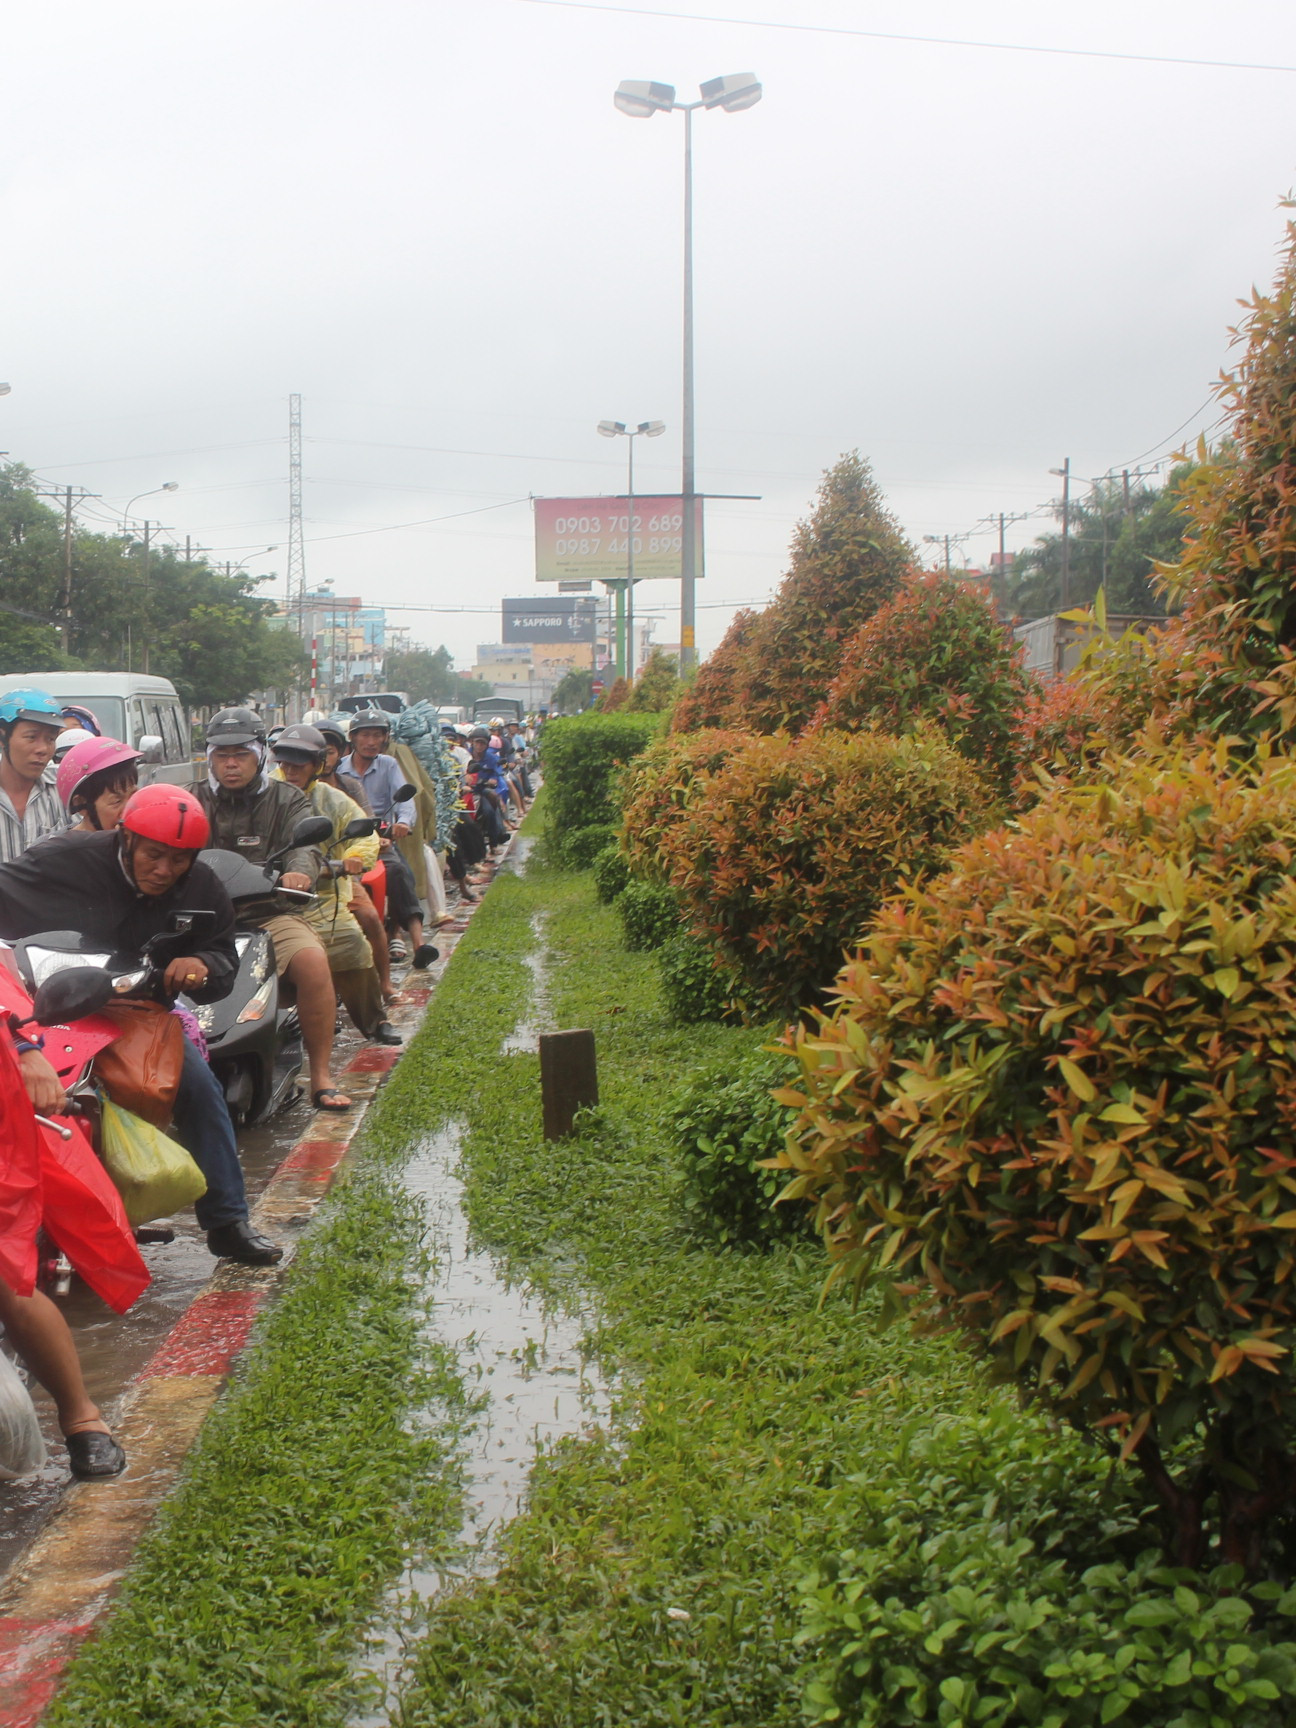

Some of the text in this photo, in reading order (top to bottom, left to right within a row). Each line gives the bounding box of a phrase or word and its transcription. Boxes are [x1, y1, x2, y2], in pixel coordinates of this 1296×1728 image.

[555, 517, 601, 534] 0903
[648, 515, 683, 532] 689
[555, 538, 601, 556] 0987
[648, 537, 682, 554] 899
[522, 617, 562, 627] SAPPORO
